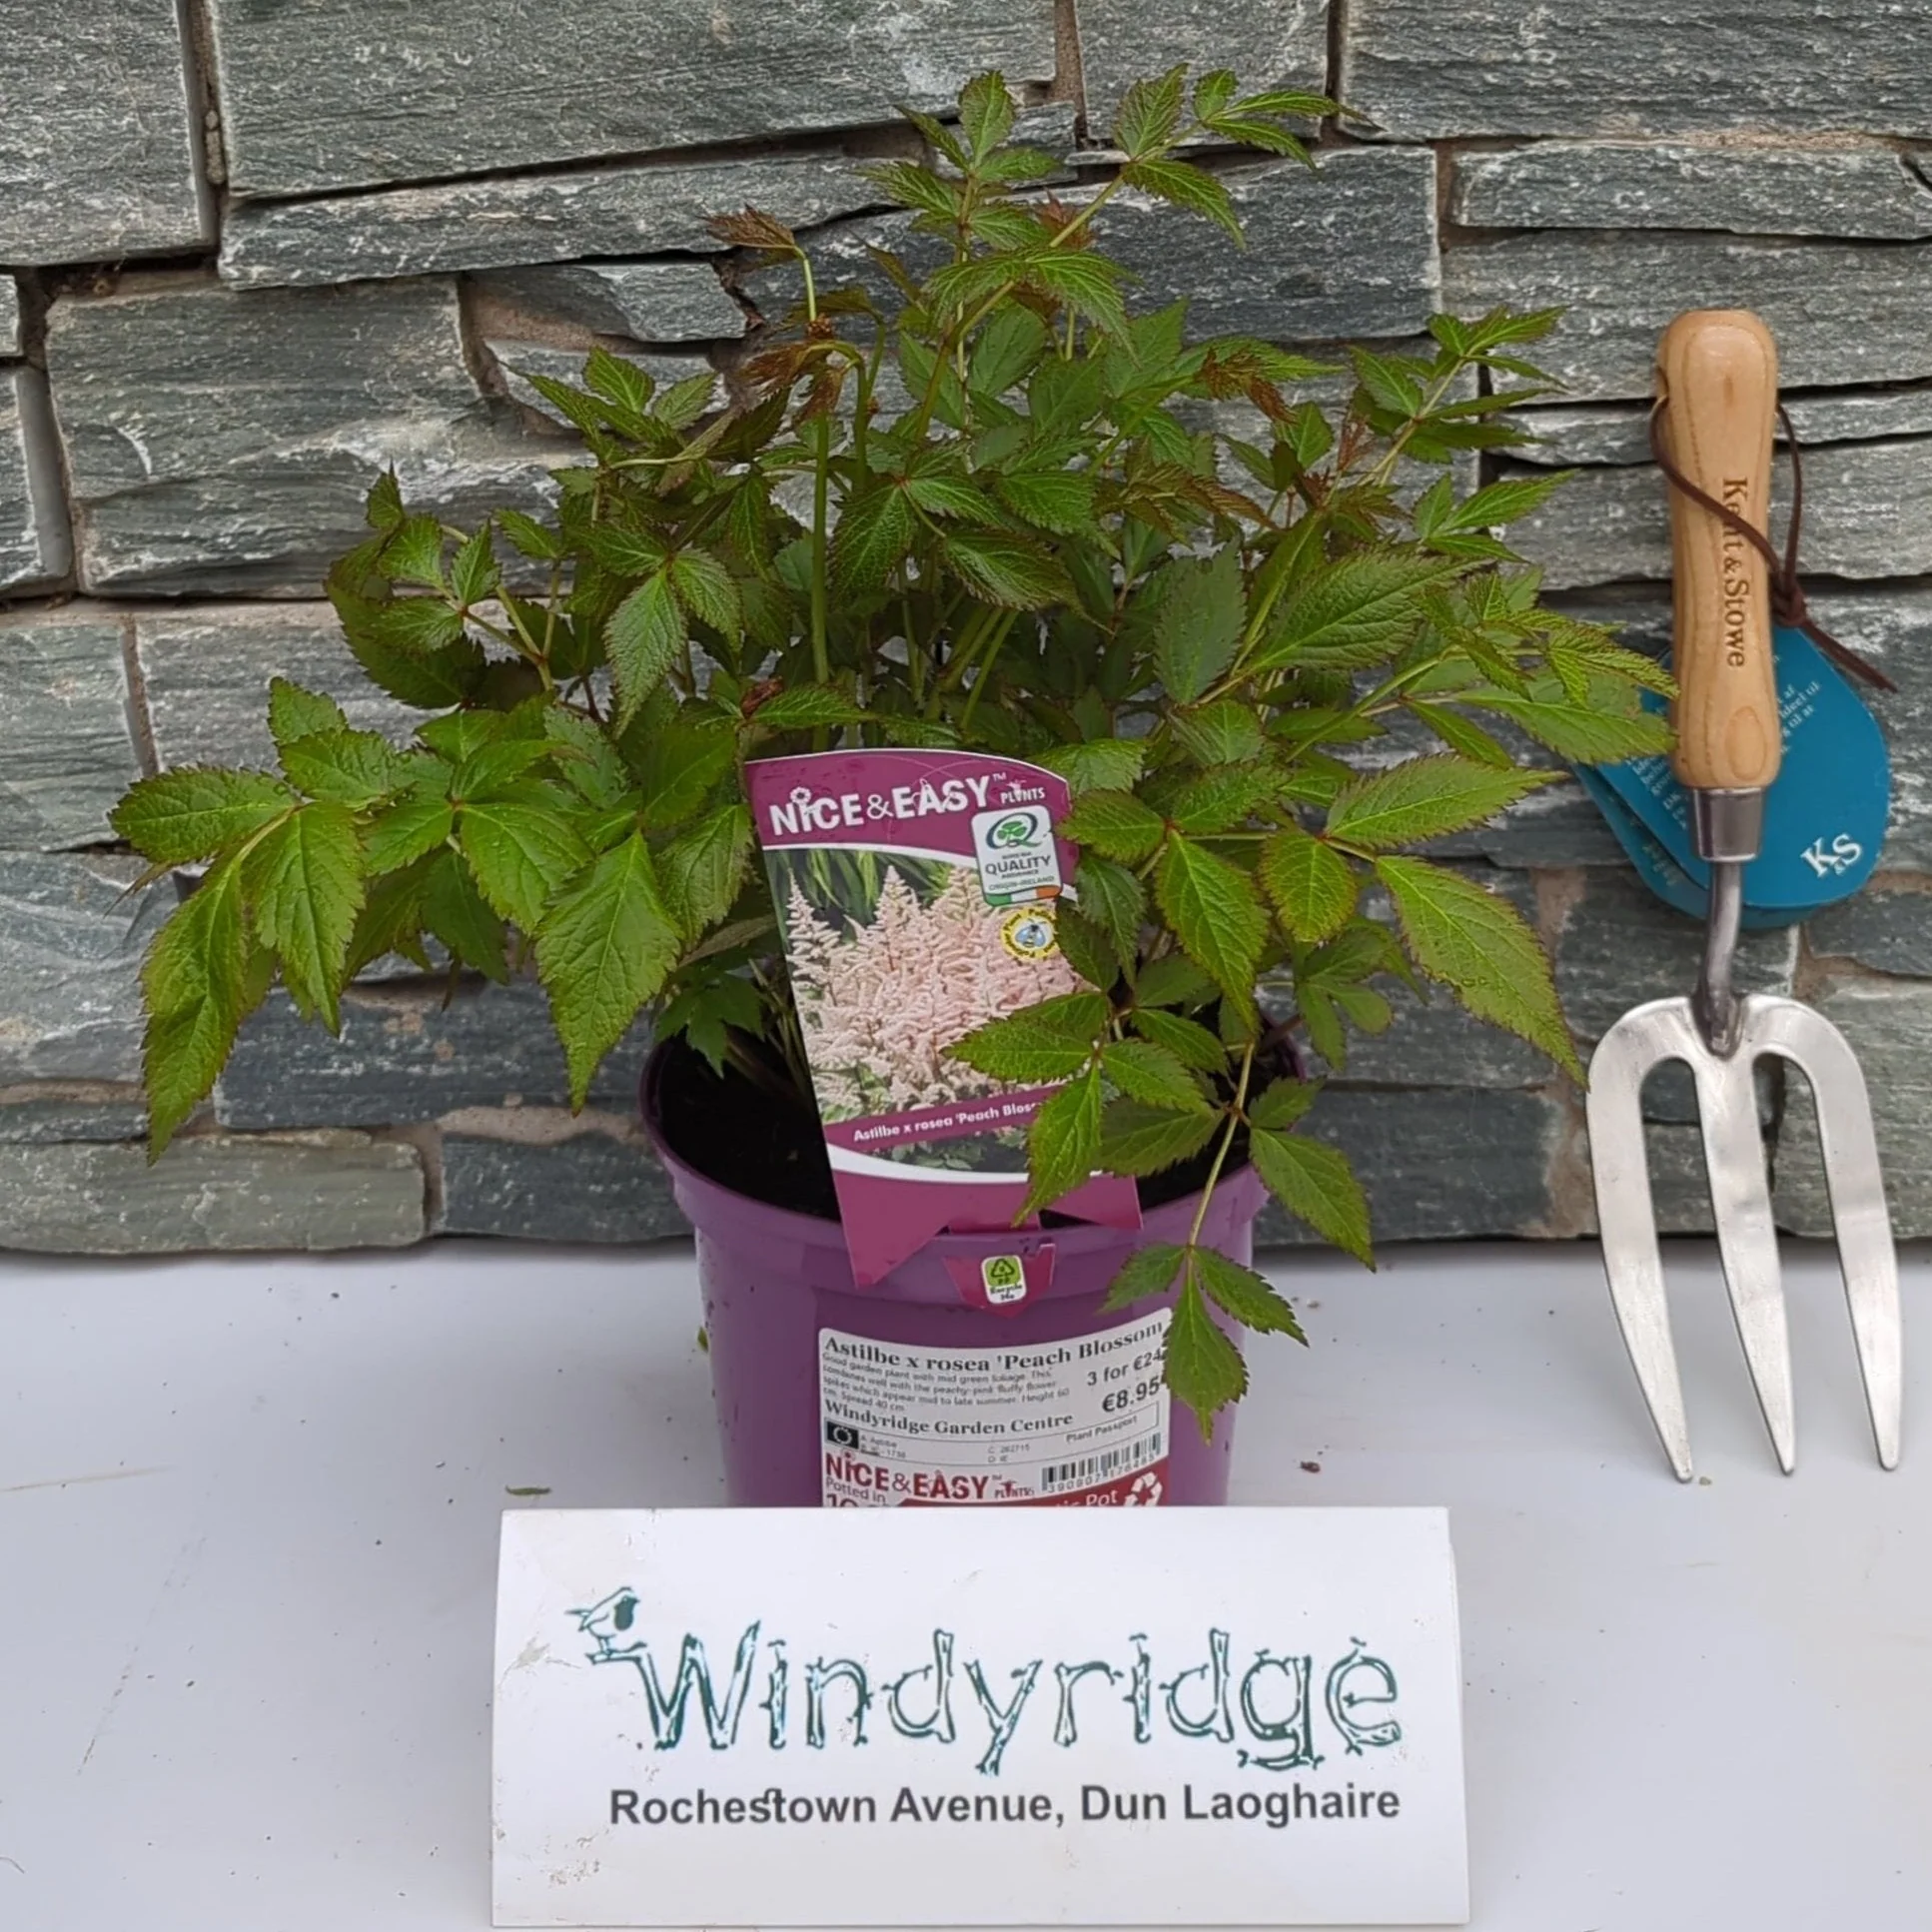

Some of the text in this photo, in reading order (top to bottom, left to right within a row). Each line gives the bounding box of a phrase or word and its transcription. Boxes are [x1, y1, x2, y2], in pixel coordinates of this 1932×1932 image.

[1724, 578, 1749, 667] Stowe
[985, 855, 1052, 876] QUALITY
[854, 1124, 900, 1142] Astilbe
[915, 1118, 953, 1132] rosea
[824, 1322, 1163, 1372] Astilbe x rosea 'Peach Blossom
[1087, 1372, 1097, 1387] 3
[1103, 1364, 1129, 1382] for
[1102, 1376, 1160, 1413] €8.95
[825, 1400, 1073, 1436] Windyridge Garden Centre
[1066, 1416, 1138, 1443] Plant Passport
[826, 1476, 869, 1499] Potted
[872, 1489, 886, 1502] in
[591, 1620, 1401, 1775] Windyridge
[609, 1783, 1401, 1828] Rochestown Avenue, Dun Laoghaire
